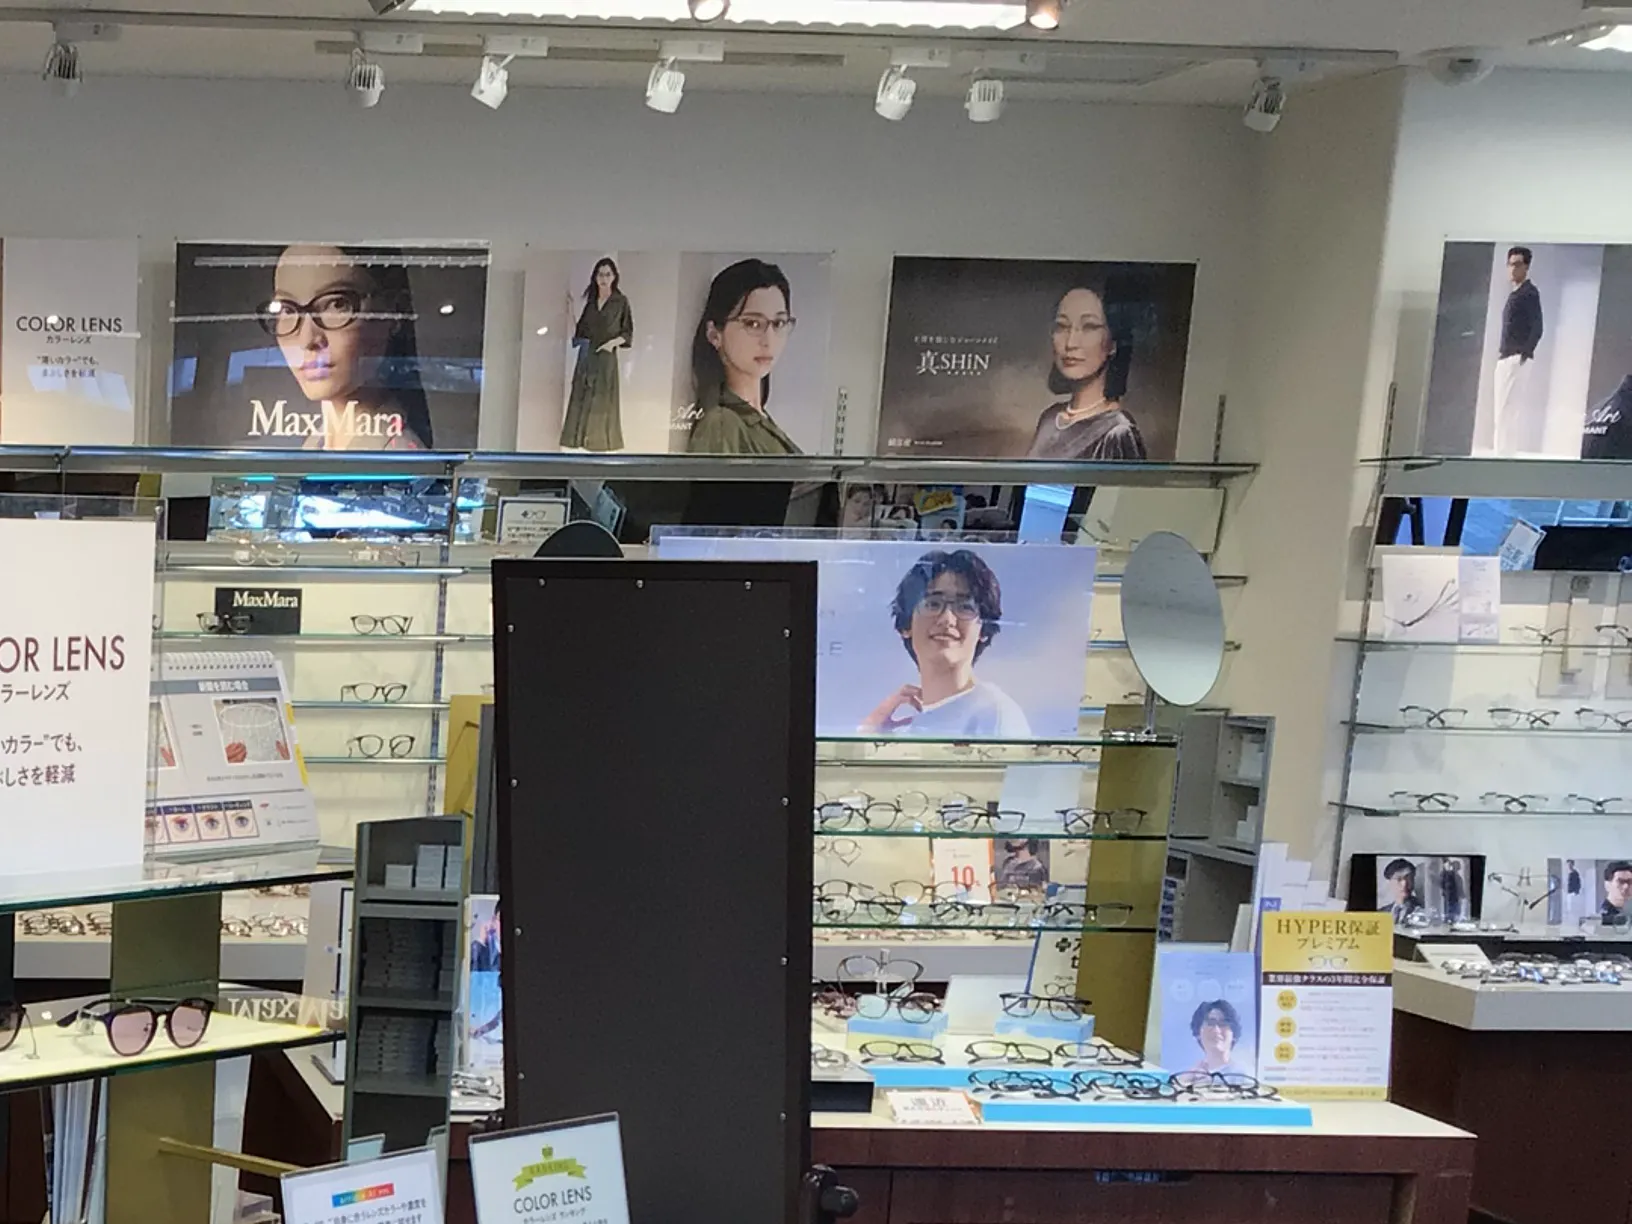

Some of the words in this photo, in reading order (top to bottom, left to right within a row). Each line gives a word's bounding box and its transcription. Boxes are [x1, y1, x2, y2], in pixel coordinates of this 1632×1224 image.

[16, 316, 76, 333] COLOR
[81, 317, 123, 333] LENS
[46, 335, 92, 345] カラーレンズ
[247, 399, 405, 437] MaxMara
[232, 590, 299, 609] MaxMara
[52, 634, 126, 673] LENS
[1276, 917, 1382, 937] HYPER保証
[1296, 937, 1361, 950] プレミアム
[513, 1191, 559, 1214] COLOR
[561, 1185, 593, 1206] LENS
